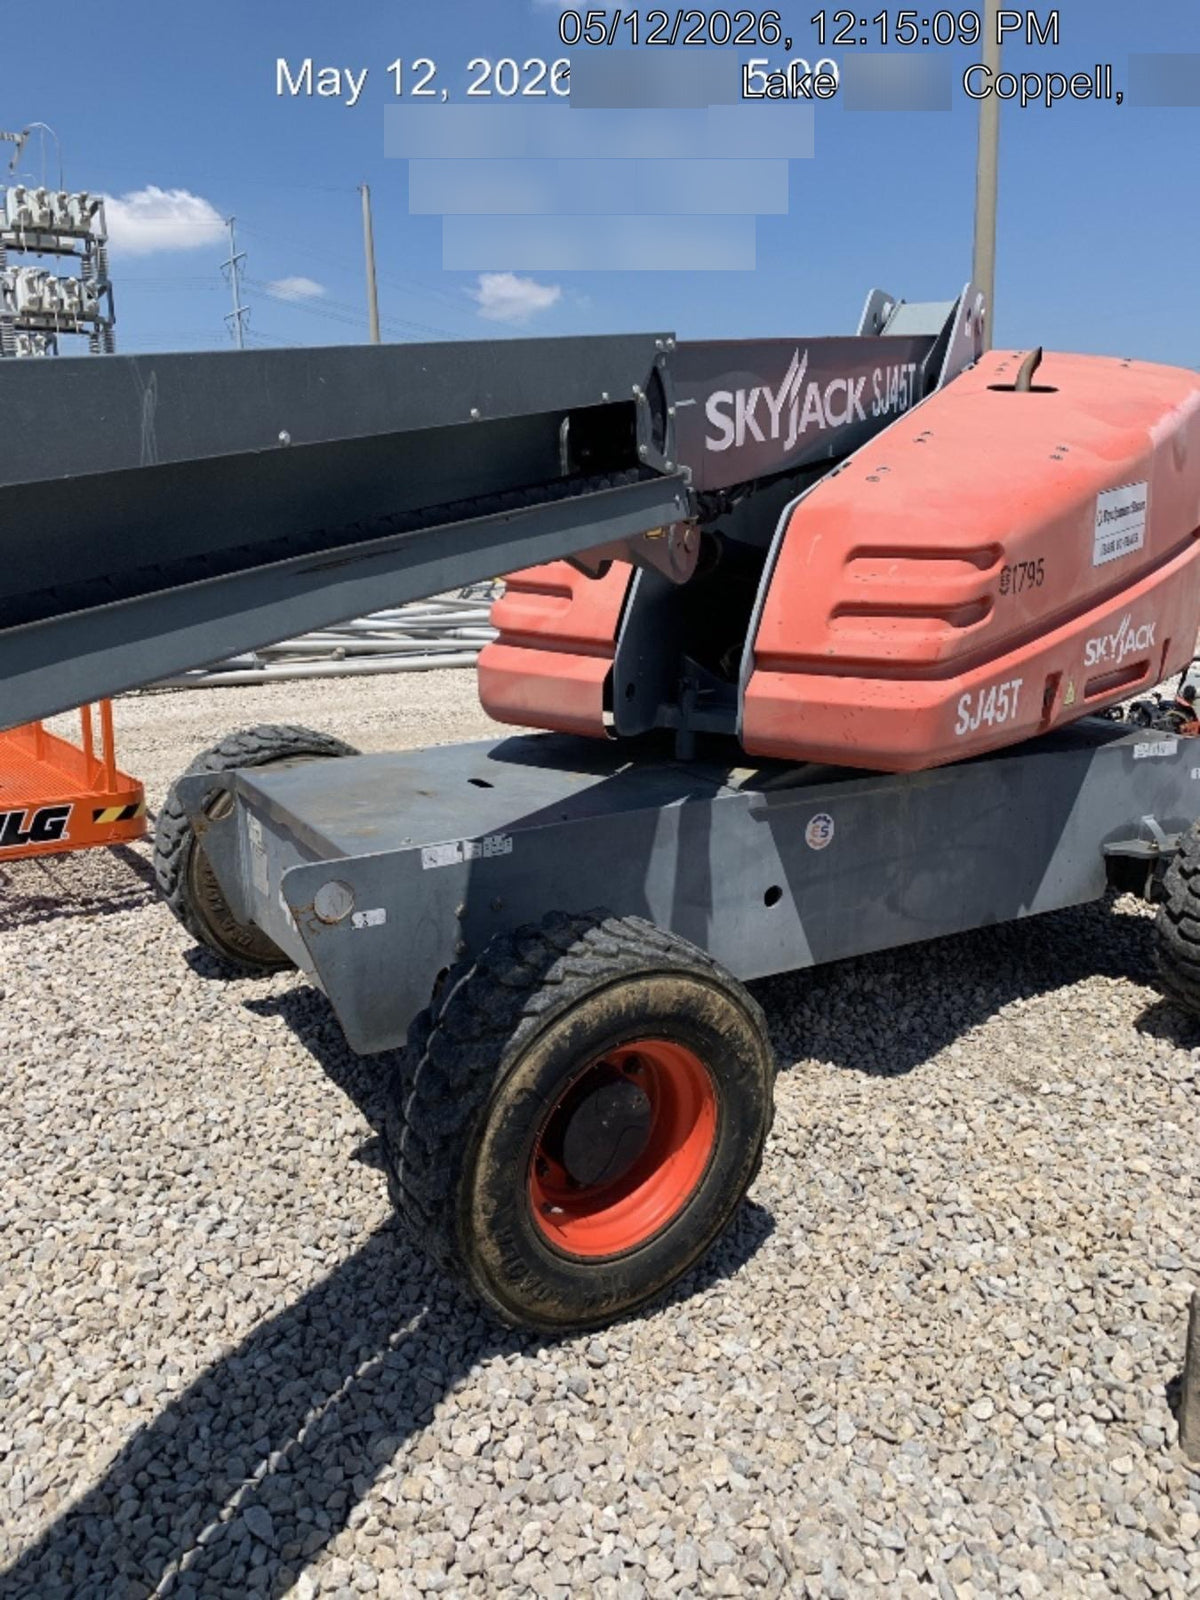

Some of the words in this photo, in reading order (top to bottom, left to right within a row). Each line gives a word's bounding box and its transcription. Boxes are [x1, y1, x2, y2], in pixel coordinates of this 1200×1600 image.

[705, 347, 867, 452] SKYJACK
[872, 362, 916, 419] SJ45T
[1084, 613, 1157, 667] SKYJACK
[954, 678, 1023, 736] SJ45T
[0, 803, 75, 849] LG
